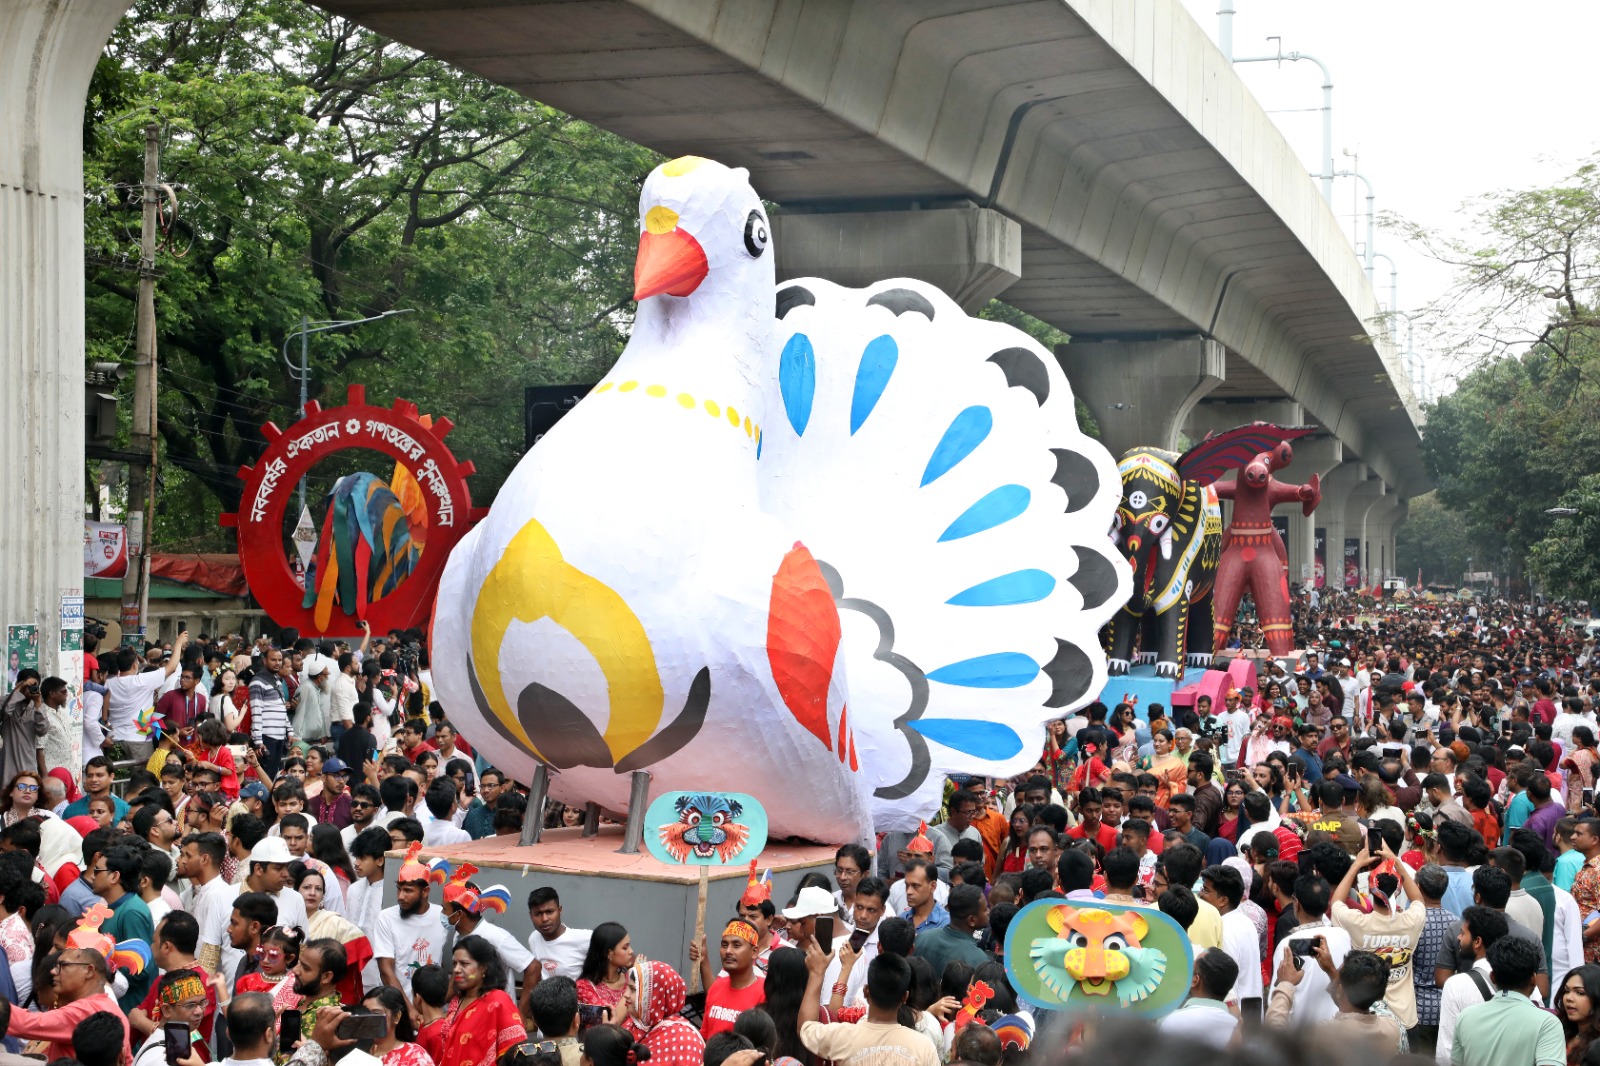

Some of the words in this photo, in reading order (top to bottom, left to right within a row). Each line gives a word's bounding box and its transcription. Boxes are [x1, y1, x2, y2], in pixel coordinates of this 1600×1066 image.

[286, 421, 340, 458] ঐকতান
[1313, 821, 1342, 832] DMP
[1362, 934, 1410, 949] TURBO
